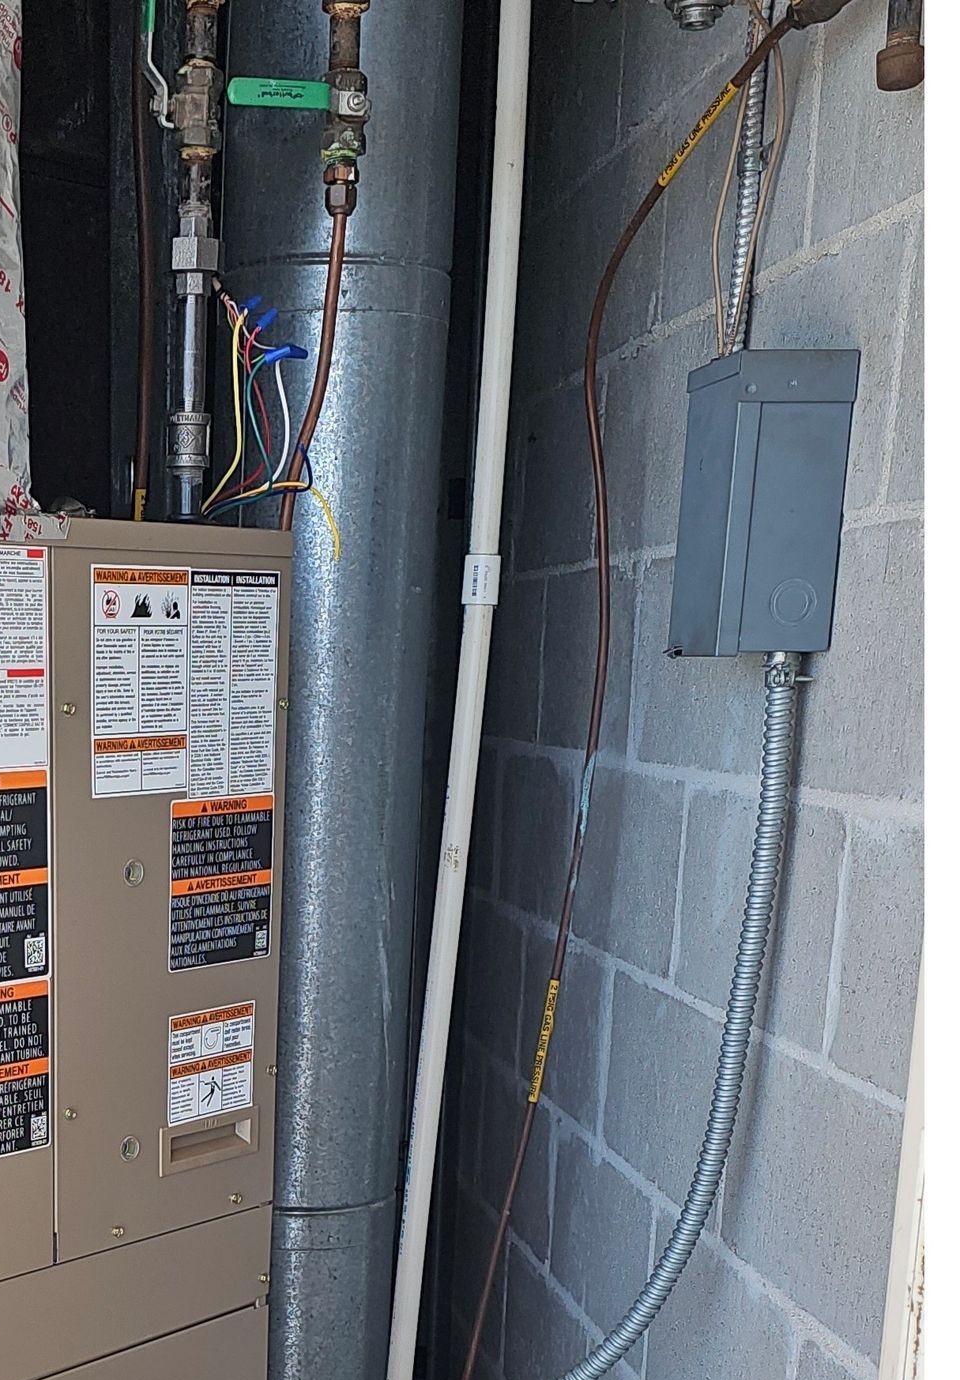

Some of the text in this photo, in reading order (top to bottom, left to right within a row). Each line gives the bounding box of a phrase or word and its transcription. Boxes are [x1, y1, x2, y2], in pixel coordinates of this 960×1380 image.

[665, 155, 678, 175] PSIG
[678, 138, 691, 157] GAS
[689, 122, 703, 141] LINE
[96, 571, 187, 583] WARNING AVERTISSEMENT
[194, 574, 276, 585] INSTALLATION INSTALLATION
[96, 737, 186, 752] WARNING AVERTISSEMENT
[210, 799, 248, 811] WARNING
[195, 874, 257, 891] AVERTISSEMENT
[546, 992, 558, 1012] PSIG
[543, 1014, 552, 1032] GAS
[539, 1034, 548, 1054] LINE
[530, 1055, 543, 1097] PRESSURE
